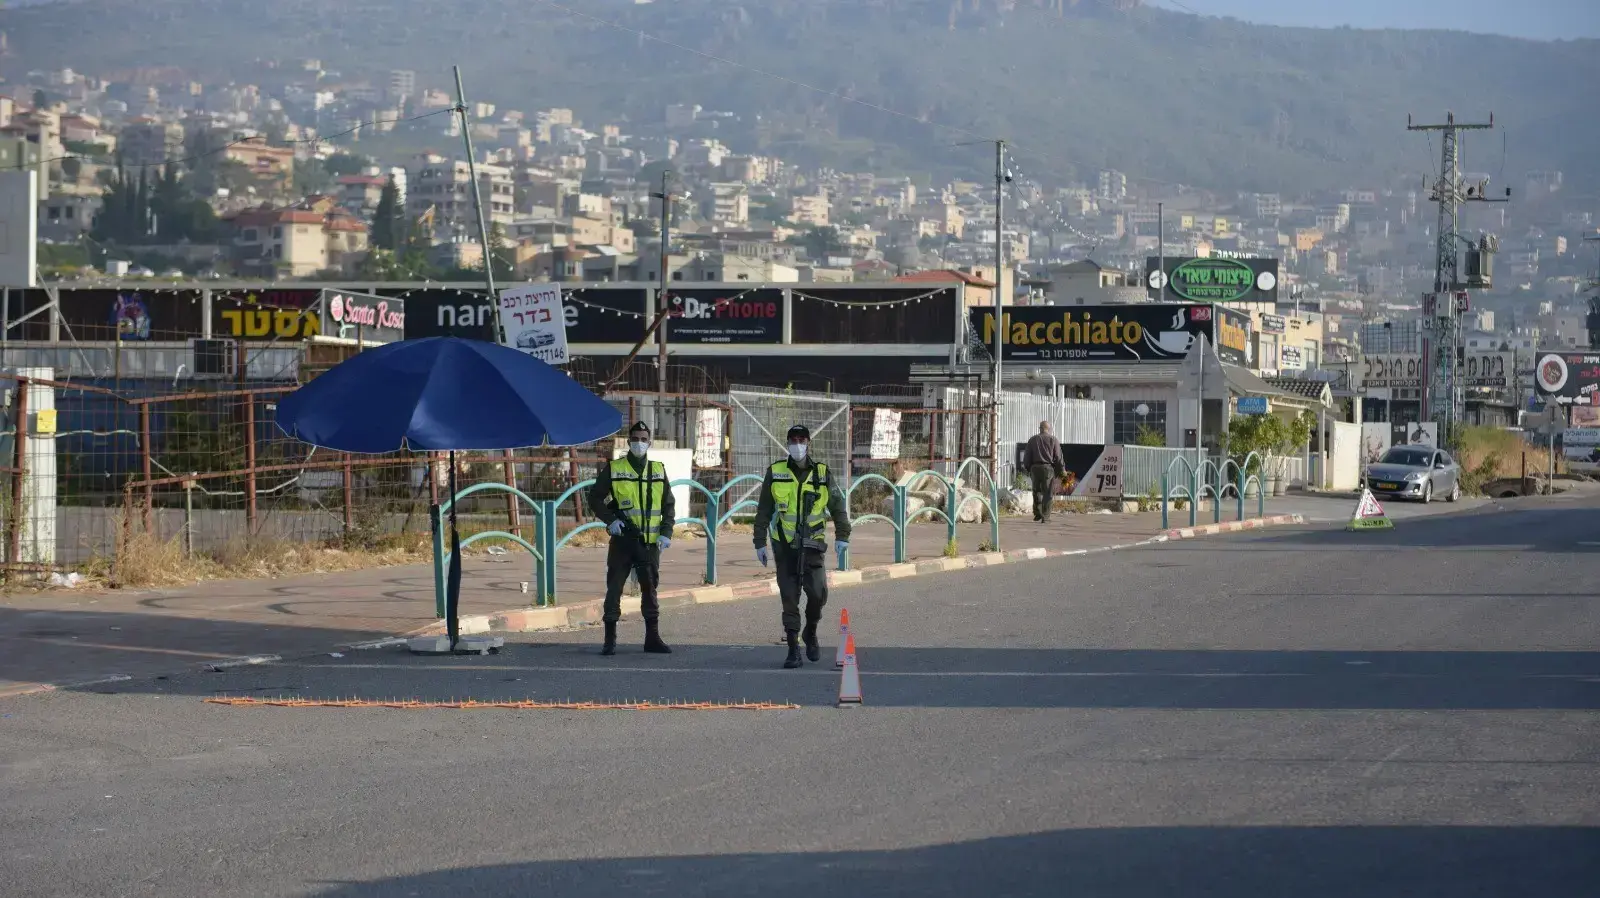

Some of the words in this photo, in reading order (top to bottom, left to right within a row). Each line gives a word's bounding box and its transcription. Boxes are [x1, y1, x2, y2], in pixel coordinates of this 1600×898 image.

[503, 295, 522, 309] רכב
[525, 290, 556, 307] רחיצת
[685, 297, 711, 319] Dr.
[715, 297, 777, 319] Phone
[345, 296, 375, 327] Santa
[375, 300, 406, 331] Rosa
[512, 307, 553, 327] בדר
[221, 310, 321, 338] אסטר
[983, 311, 1143, 346] Macchiato
[1040, 349, 1051, 359] בר
[1053, 349, 1088, 359] אספרסו
